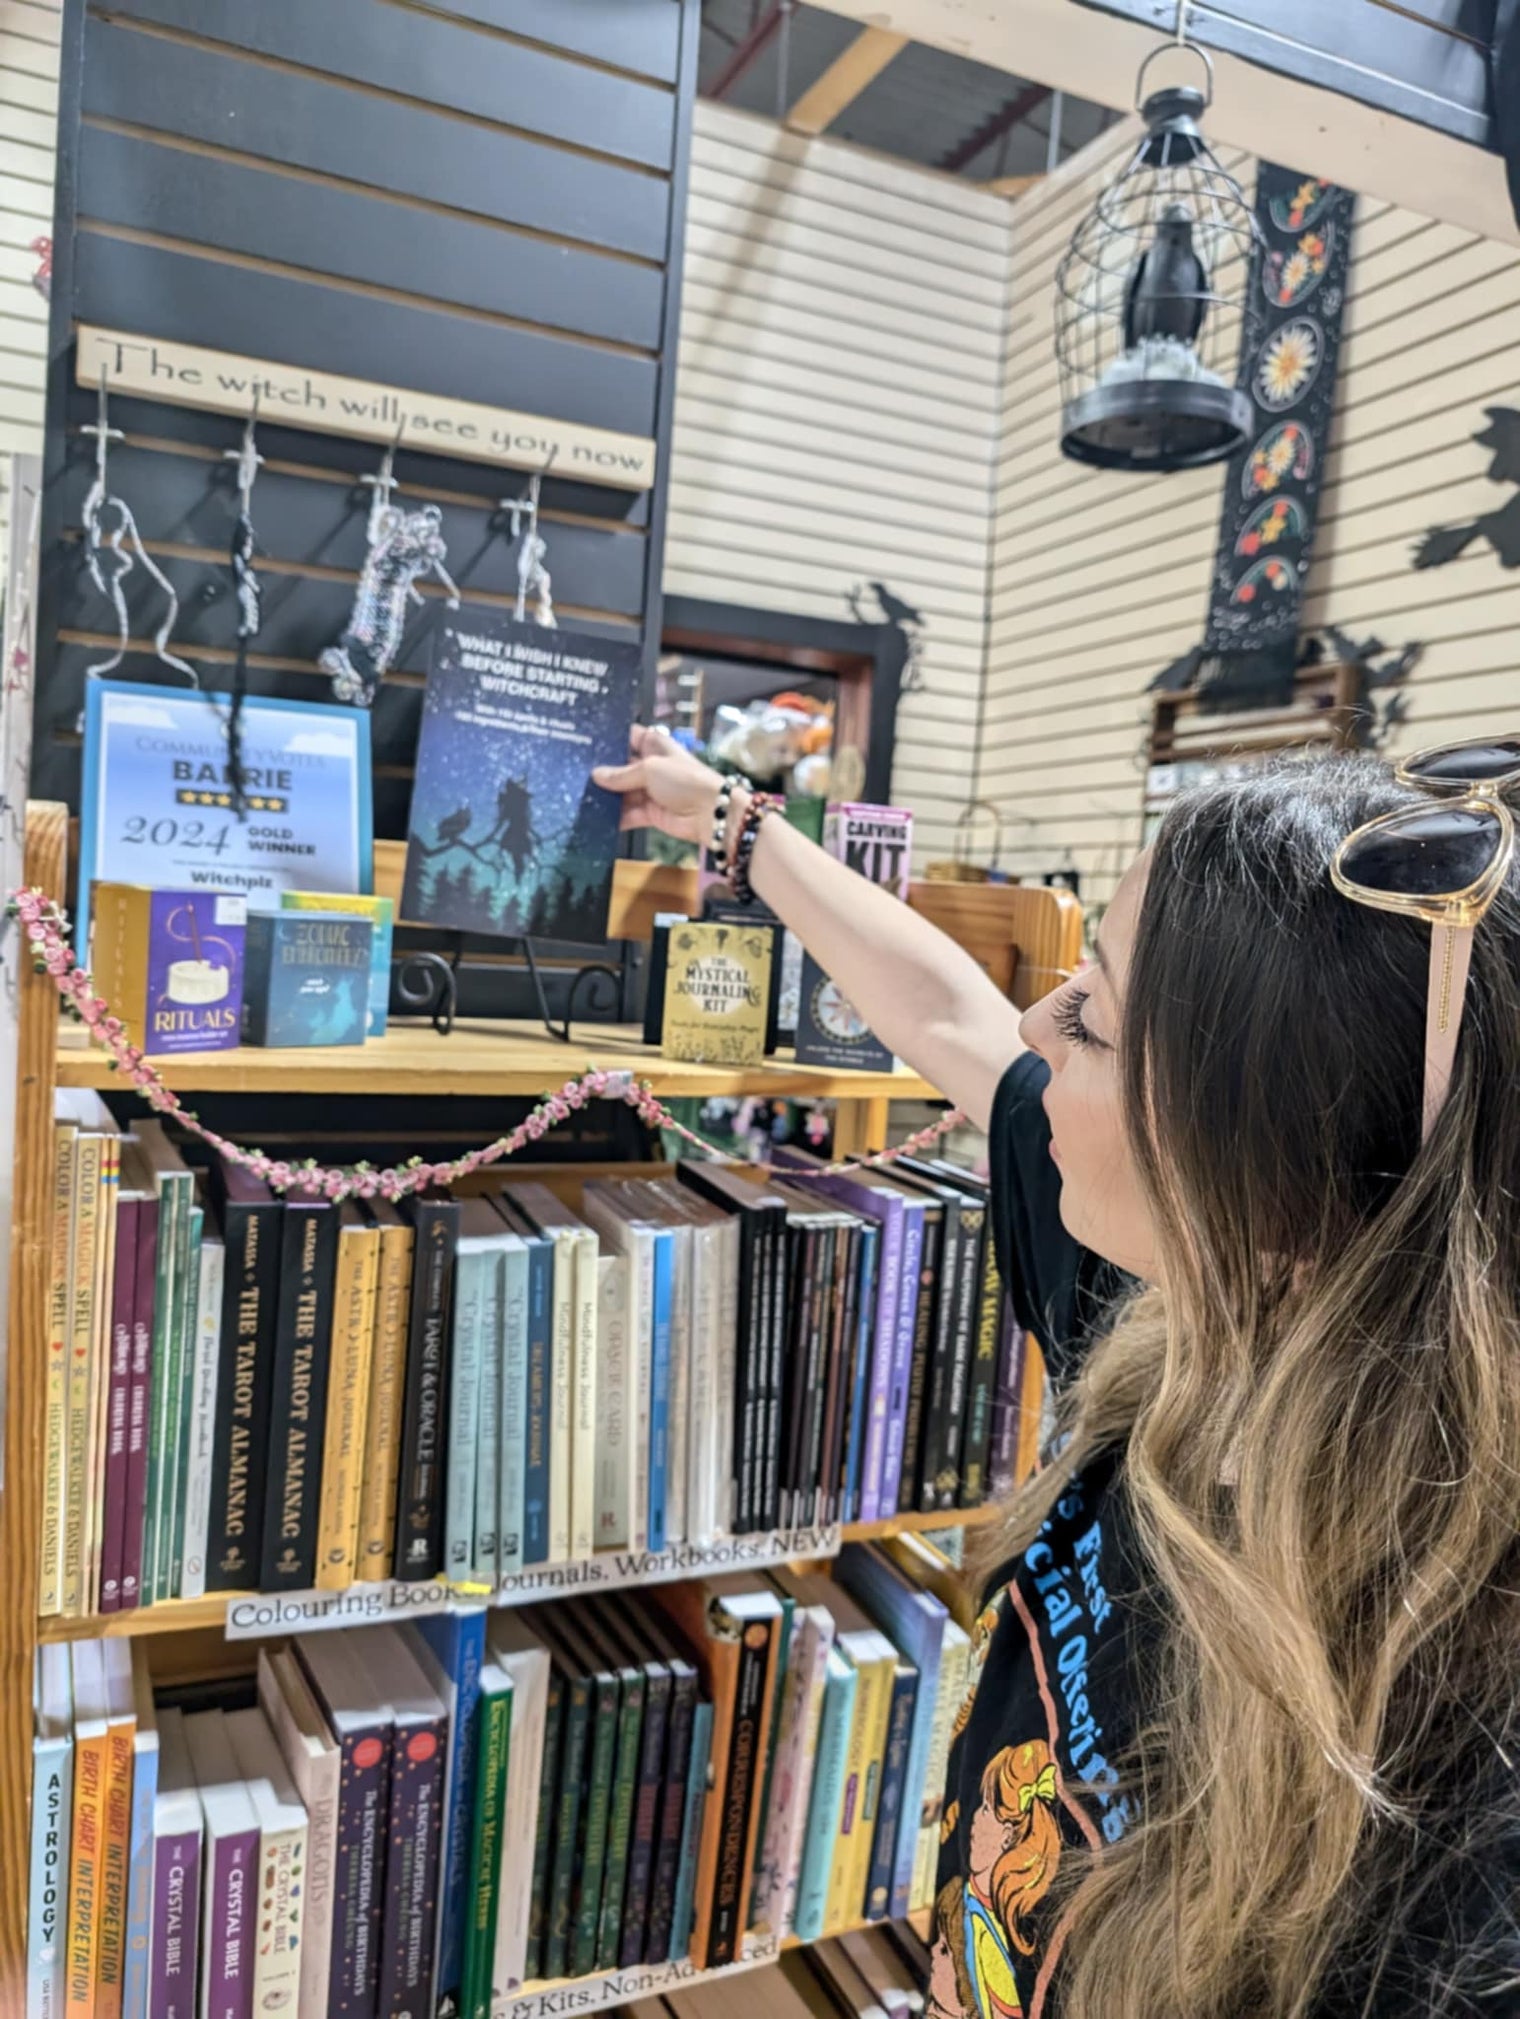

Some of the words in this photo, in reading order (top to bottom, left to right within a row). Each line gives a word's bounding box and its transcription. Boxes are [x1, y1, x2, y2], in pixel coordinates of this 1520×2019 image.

[96, 338, 202, 385] The
[216, 373, 327, 409] witch
[340, 393, 398, 427] will
[411, 413, 479, 440] see
[491, 428, 559, 457] you
[572, 445, 644, 472] now
[456, 632, 502, 656] WHAT
[503, 643, 512, 658] I
[514, 644, 553, 666] WISH
[553, 652, 560, 667] I
[562, 655, 609, 676] KNEW
[461, 653, 525, 676] BEFORE
[526, 667, 600, 693] STARTING
[479, 675, 578, 706] WITCHCRAFT
[121, 816, 231, 856] 2024
[248, 827, 293, 839] GOLD
[248, 840, 316, 856] WINNER
[847, 821, 907, 840] CARVING
[191, 870, 273, 891] Witchplz
[846, 840, 906, 884] KIT
[674, 982, 762, 1008] JOURNALING
[686, 965, 750, 983] MYSTICAL
[154, 1008, 236, 1032] RITUALS
[702, 999, 728, 1013] KIT
[57, 1140, 71, 1196] COLOR
[81, 1148, 96, 1204] COLOR
[57, 1200, 69, 1211] A
[80, 1208, 93, 1218] A
[52, 1213, 69, 1282] MAGICK
[77, 1222, 92, 1287] MAGICK
[245, 1214, 259, 1269] MATASSA
[302, 1218, 318, 1272] MATASSA
[52, 1282, 66, 1329] SPELL
[75, 1290, 89, 1336] SPELL
[239, 1286, 260, 1335] THE
[295, 1290, 317, 1338] THE
[900, 1274, 917, 1312] Coven
[422, 1314, 443, 1371] TAROT
[459, 1302, 477, 1369] Crystal
[505, 1298, 523, 1366] Crystal
[581, 1302, 592, 1379] Mindfulness
[978, 1297, 998, 1361] MAGIC
[233, 1341, 256, 1418] TAROT
[290, 1345, 313, 1421] TAROT
[421, 1372, 437, 1388] &
[340, 1395, 355, 1458] JOURNAL
[416, 1388, 437, 1461] ORACLE
[457, 1375, 476, 1446] Journal
[505, 1371, 522, 1440] Journal
[580, 1384, 592, 1430] Journal
[608, 1391, 622, 1446] CARD
[46, 1402, 62, 1502] HEDGEWALKER
[68, 1407, 84, 1506] HEDGEWALKER
[226, 1425, 251, 1536] ALMANAC
[282, 1428, 307, 1539] ALMANAC
[43, 1518, 60, 1576] DANIELS
[65, 1522, 81, 1578] DANIELS
[231, 1589, 385, 1639] Colouring
[616, 1536, 764, 1578] Workbooks,
[772, 1525, 840, 1556] NEW
[1073, 1520, 1114, 1634] First
[83, 1749, 99, 1796] BIRTH
[112, 1736, 128, 1783] BIRTH
[110, 1788, 126, 1837] CHART
[366, 1789, 378, 1808] The
[419, 1783, 431, 1800] The
[720, 1718, 755, 1905] CORRESPONDENCES
[81, 1802, 98, 1853] CHART
[173, 1845, 182, 1860] THE
[412, 1803, 429, 1902] ENCYCLOPEDIA
[40, 1773, 61, 1943] ASTROLOGY
[232, 1848, 242, 1864] THE
[278, 1843, 291, 1867] THE
[358, 1809, 376, 1910] ENCYCLOPEDIA
[101, 1843, 123, 1985] INTERPRETATION
[166, 1866, 184, 1933] CRYSTAL
[226, 1869, 244, 1937] CRYSTAL
[276, 1871, 290, 1922] CRYSTAL
[357, 1912, 369, 1924] of
[411, 1904, 423, 1916] of
[72, 1858, 95, 2003] INTERPRETATION
[274, 1924, 287, 1955] BIBLE
[406, 1917, 422, 1988] BIRTHDAYS
[165, 1937, 181, 1977] BIBLE
[224, 1939, 240, 1980] BIBLE
[353, 1925, 369, 1996] BIRTHDAYS
[538, 1987, 596, 2018] Kits,
